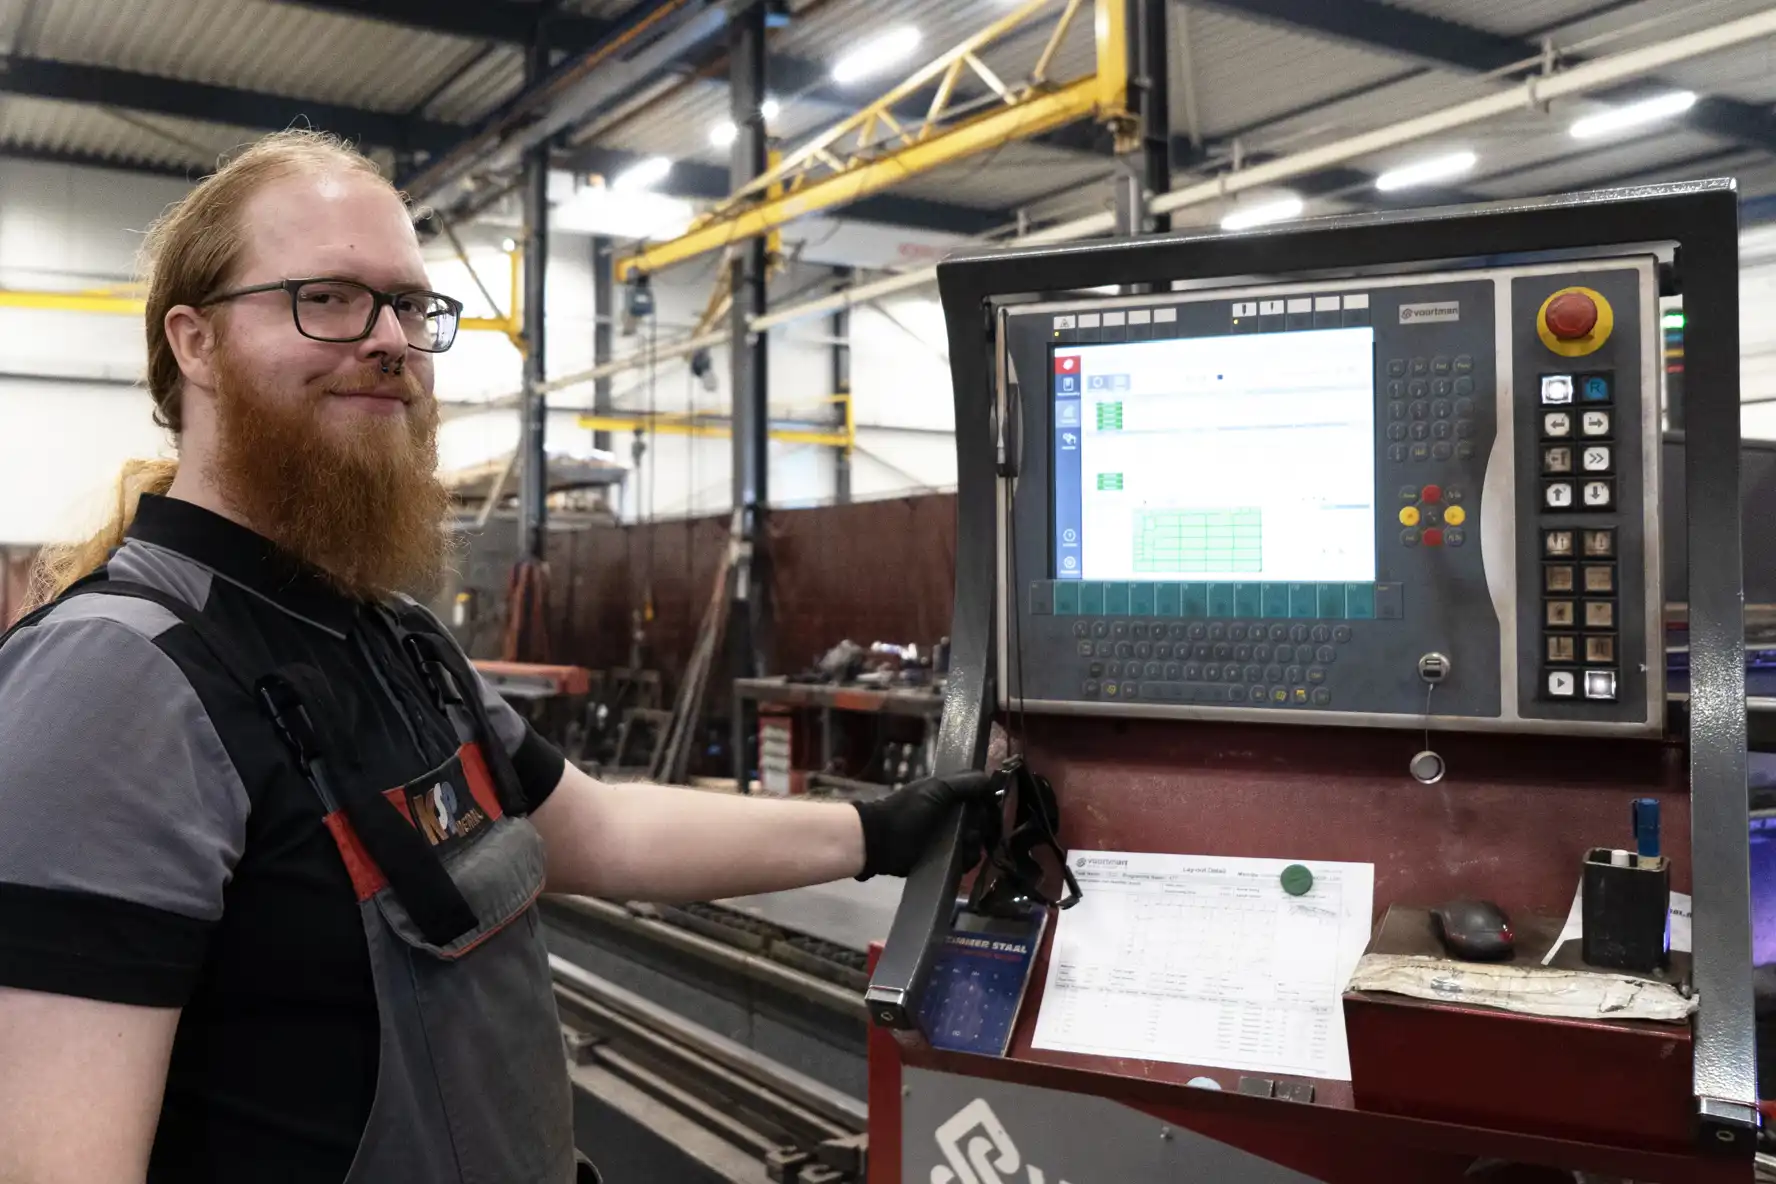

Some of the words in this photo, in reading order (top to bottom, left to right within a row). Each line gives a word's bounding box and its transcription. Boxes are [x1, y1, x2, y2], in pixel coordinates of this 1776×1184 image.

[1413, 306, 1458, 318] voortman
[1589, 380, 1601, 394] R
[991, 941, 1028, 954] STAAL
